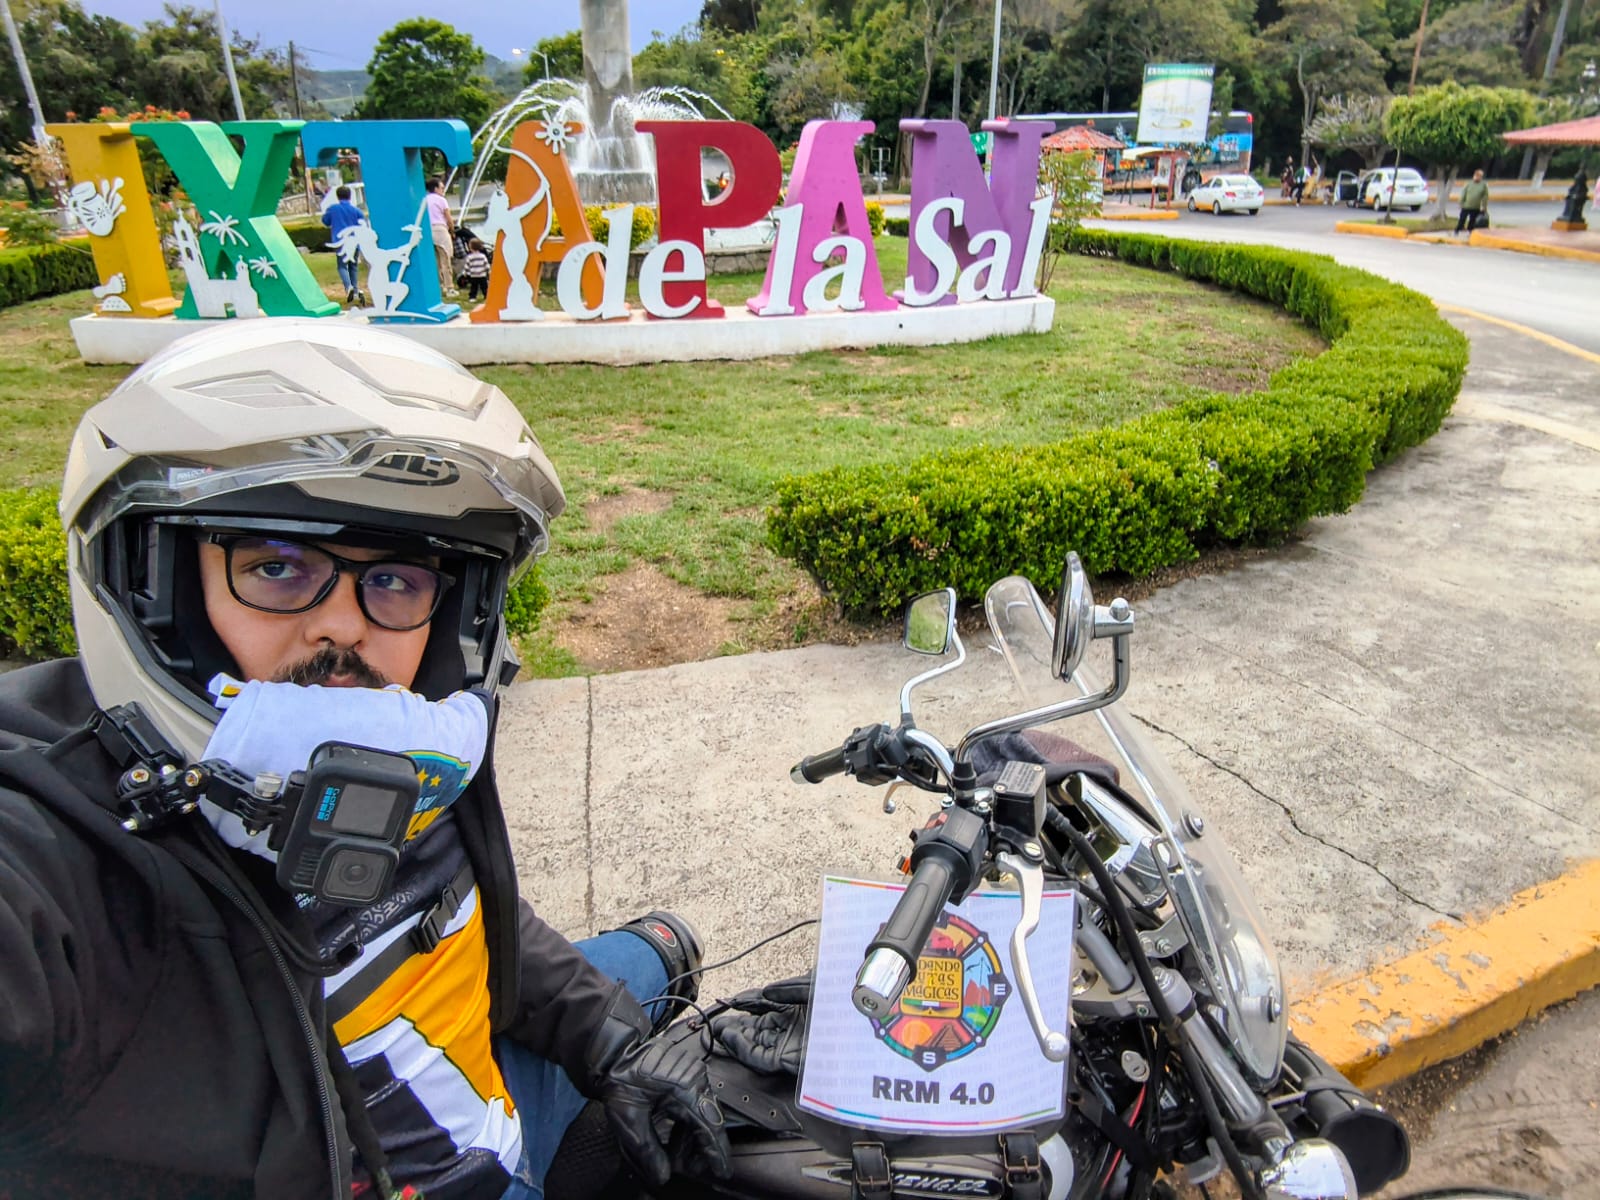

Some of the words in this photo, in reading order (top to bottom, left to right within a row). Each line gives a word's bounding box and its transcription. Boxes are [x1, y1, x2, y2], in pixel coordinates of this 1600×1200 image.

[46, 118, 1057, 324] IXTAPAN
[556, 203, 706, 321] de
[757, 202, 867, 317] la
[903, 196, 1054, 308] Sal
[993, 983, 1007, 996] E
[922, 1051, 936, 1065] S
[872, 1075, 940, 1105] RRM
[949, 1082, 996, 1106] 4.0
